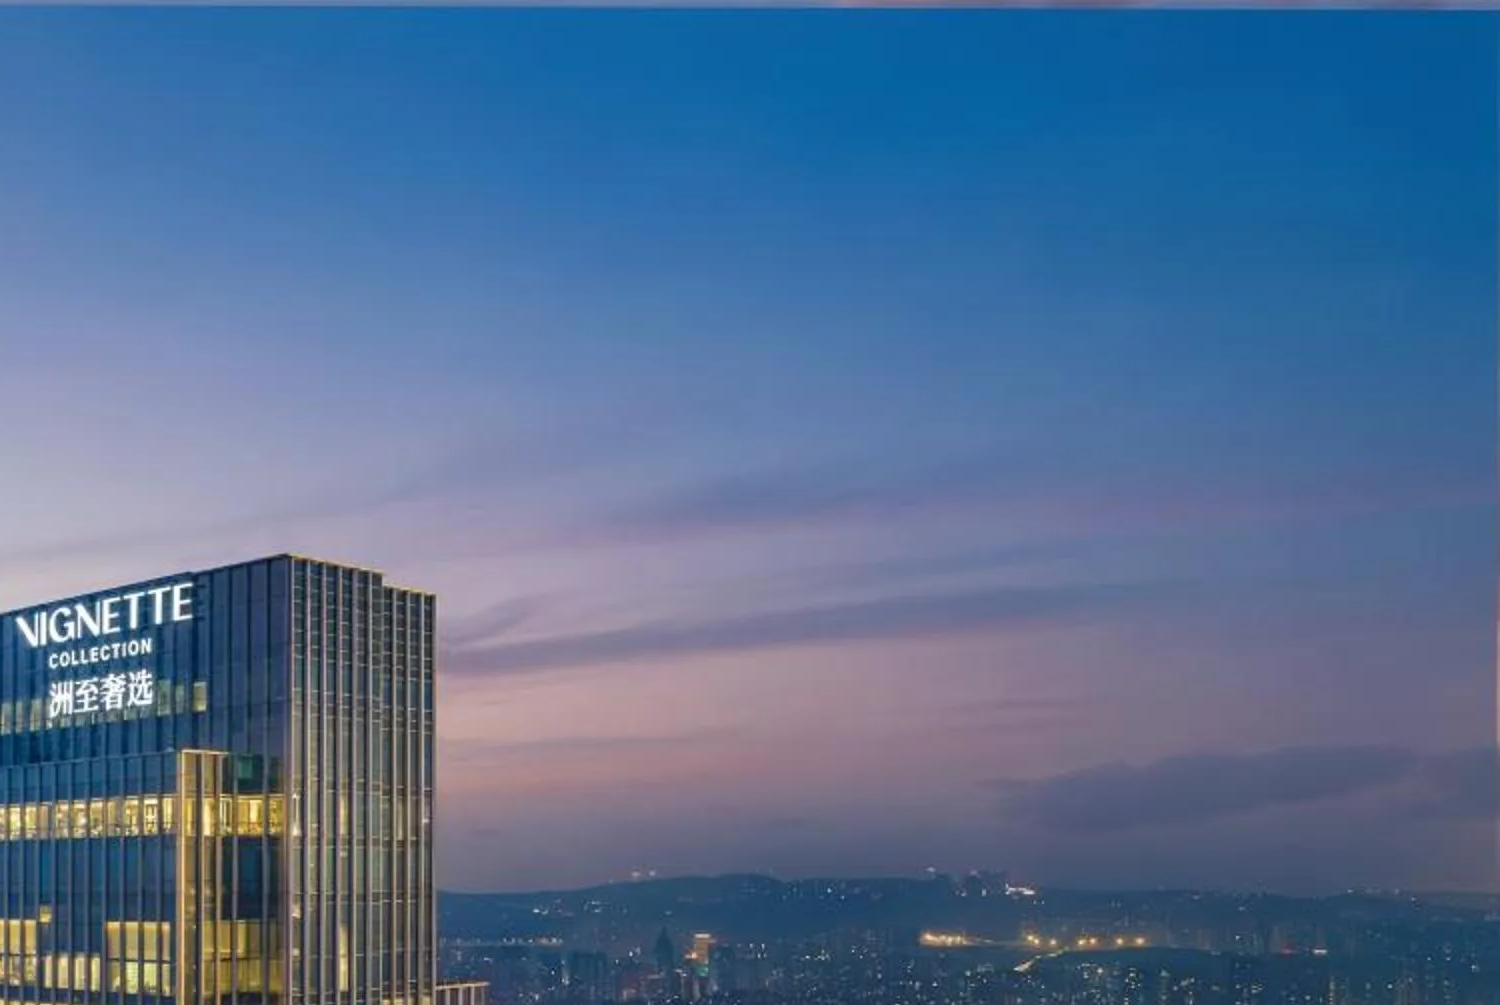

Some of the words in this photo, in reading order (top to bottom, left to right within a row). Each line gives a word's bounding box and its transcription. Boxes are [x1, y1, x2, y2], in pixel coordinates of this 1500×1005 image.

[15, 582, 194, 648] VIGNETTE
[48, 638, 152, 669] COLLECTION
[48, 668, 154, 719] 洲至奢选
